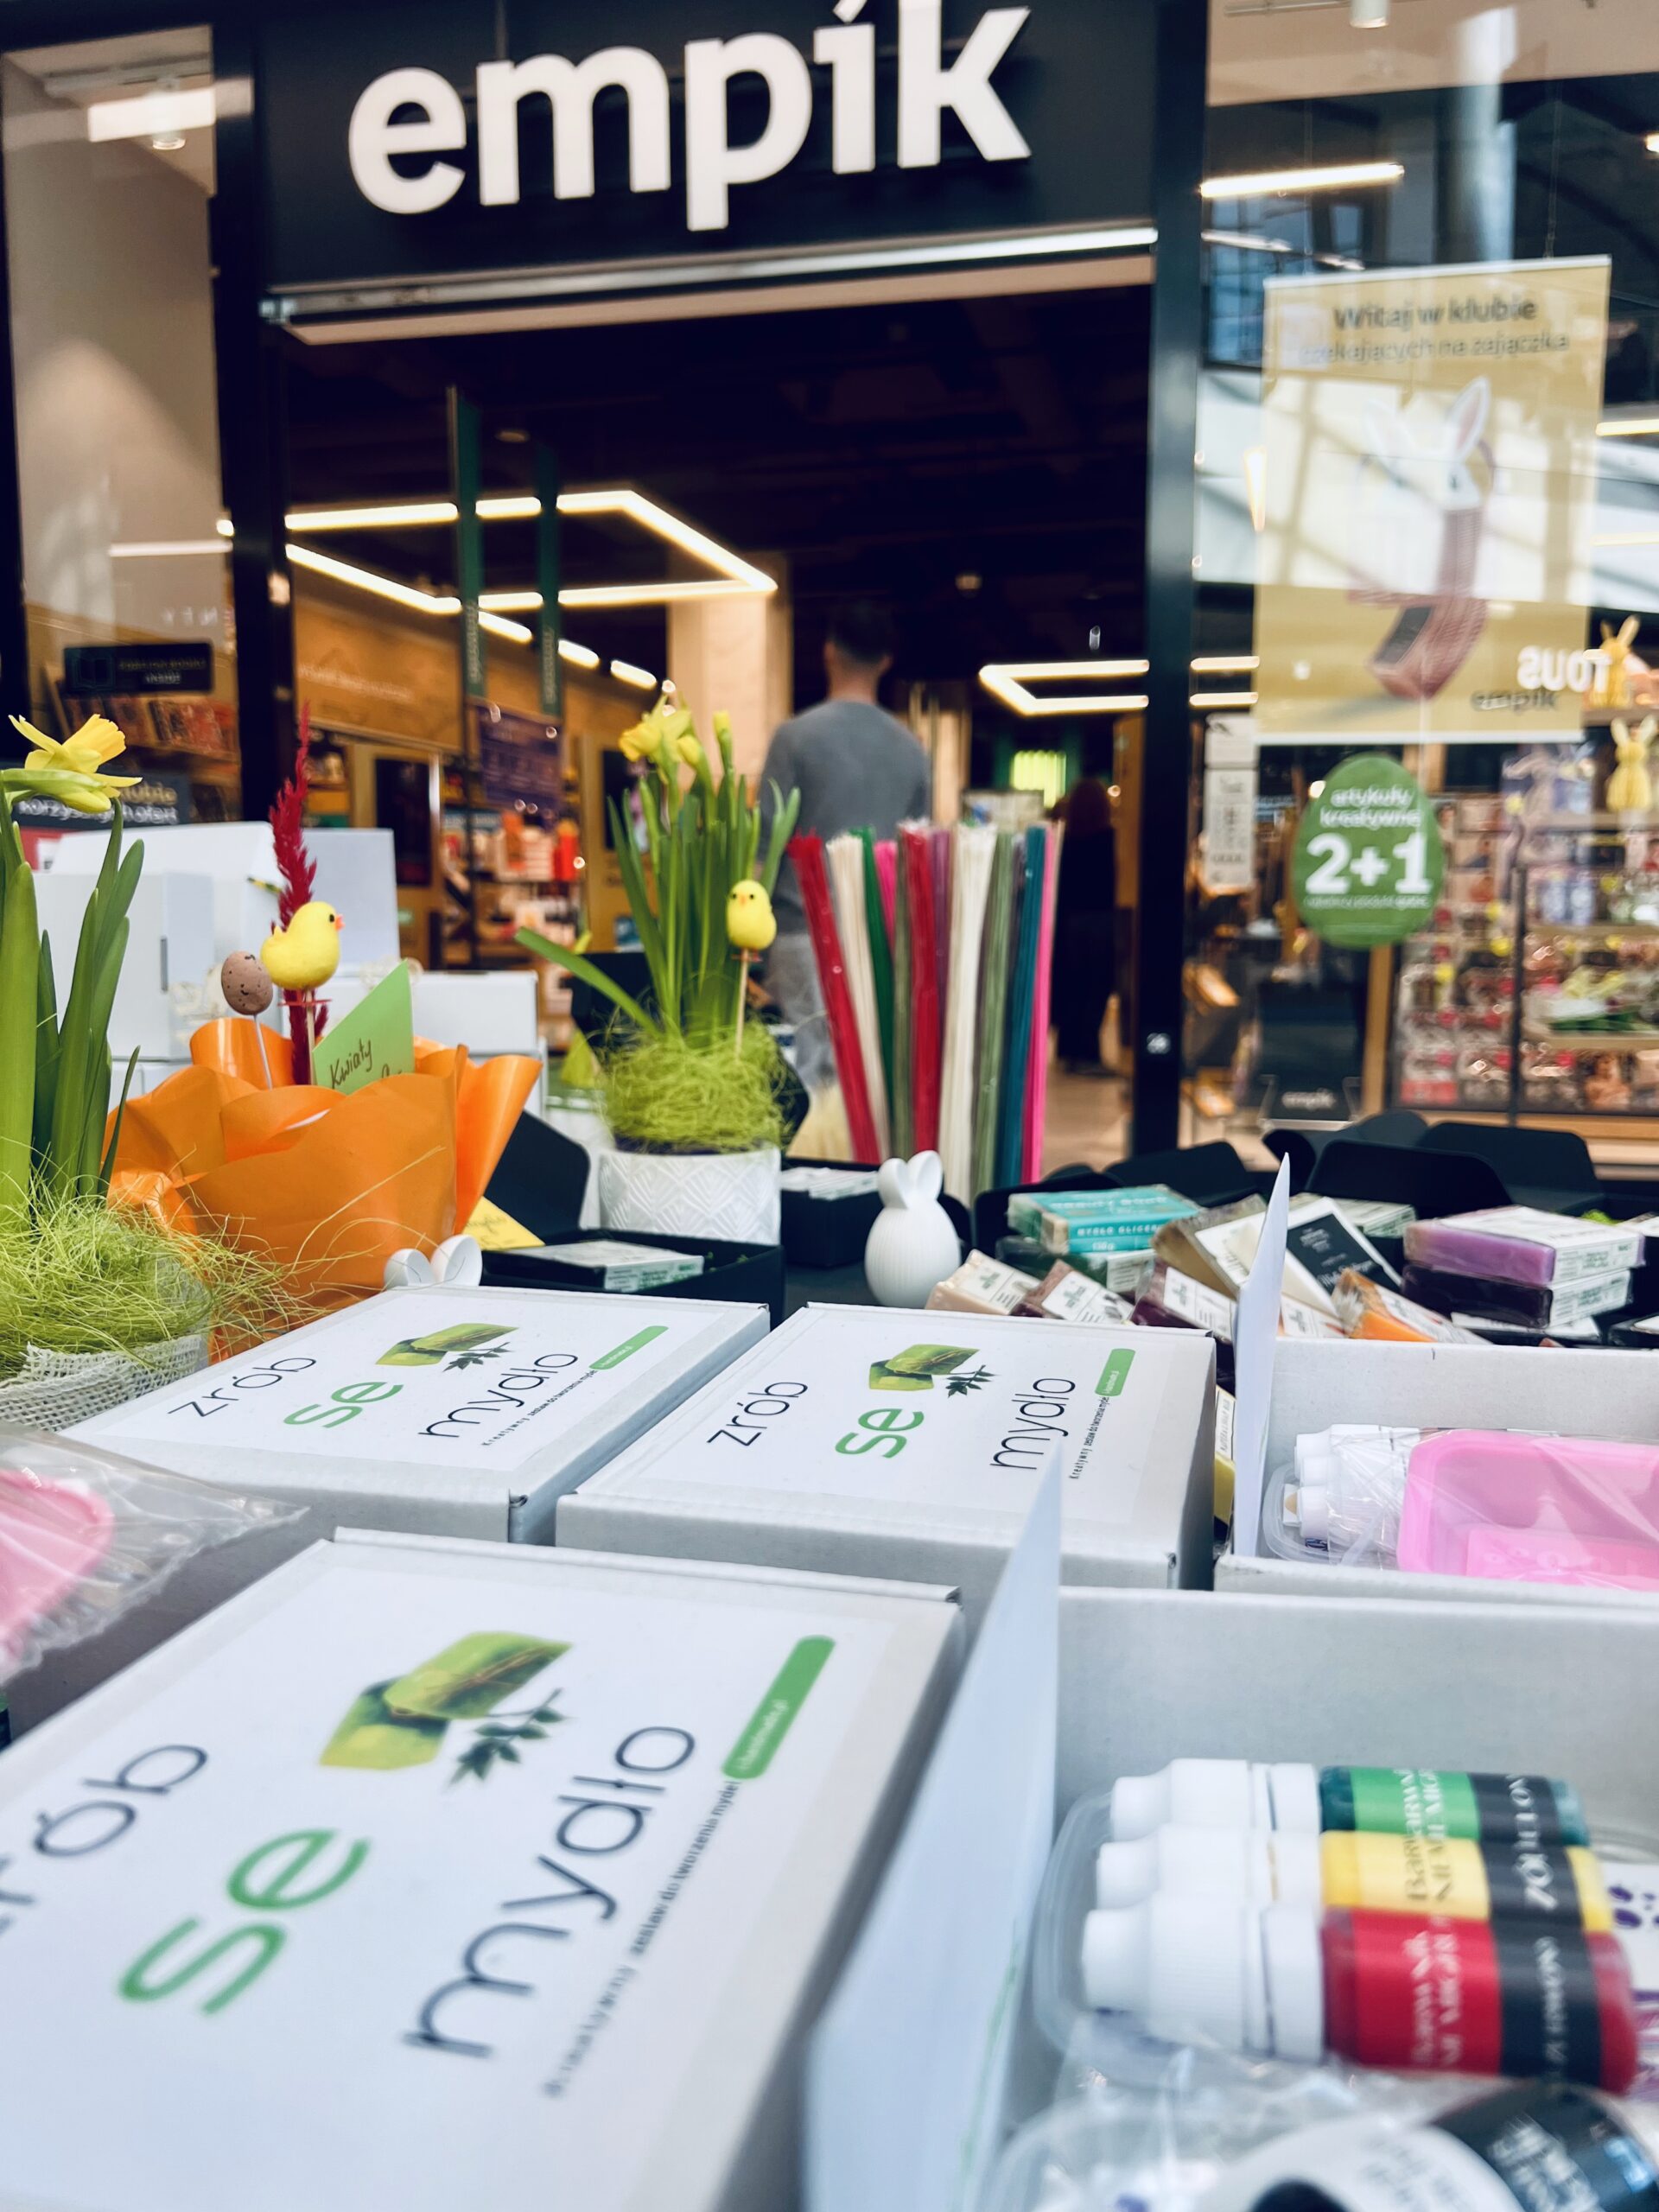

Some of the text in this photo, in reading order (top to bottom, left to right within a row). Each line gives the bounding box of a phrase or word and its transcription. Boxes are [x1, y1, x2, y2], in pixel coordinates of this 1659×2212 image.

[348, 0, 1033, 232] empik
[1332, 295, 1537, 332] Witaj w klubie
[1306, 832, 1433, 894] 2+1
[330, 1038, 373, 1090] Kwiaty
[168, 1357, 317, 1420] zrób
[283, 1382, 404, 1429] se
[417, 1353, 579, 1439] mydło
[706, 1382, 809, 1447] zrób
[835, 1408, 925, 1459] se
[989, 1377, 1076, 1470] mydło
[0, 1745, 207, 1936] ób
[116, 1827, 373, 2018] se
[400, 1725, 696, 2062] mydło
[661, 1878, 682, 1908] do
